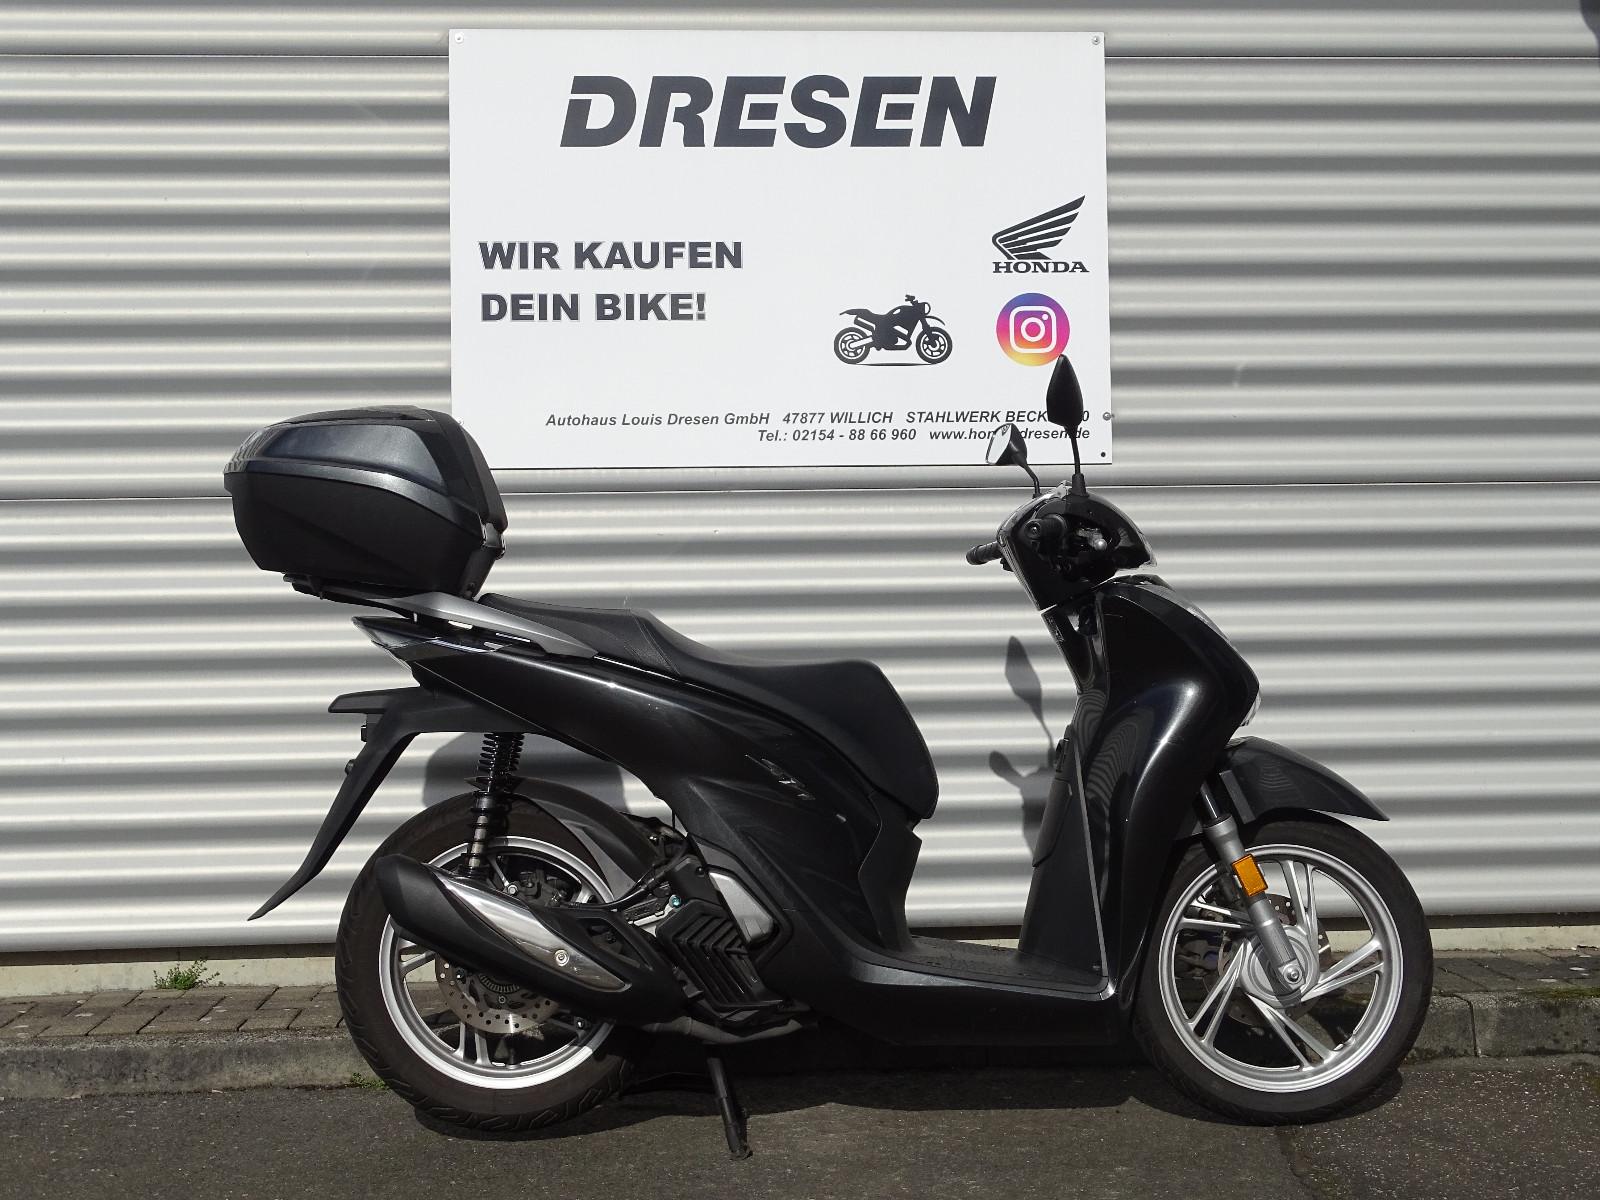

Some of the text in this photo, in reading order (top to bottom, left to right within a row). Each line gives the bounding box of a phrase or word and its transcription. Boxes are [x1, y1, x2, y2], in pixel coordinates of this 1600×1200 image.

[560, 75, 997, 148] DRESEN
[479, 241, 743, 270] WIR KAUFEN
[992, 261, 1090, 274] HONDA
[481, 293, 707, 322] DEIN BIKE!
[545, 413, 617, 427] Autohaus
[621, 413, 663, 426] Louis
[667, 413, 719, 426] Dresen
[724, 412, 770, 425] GmbH
[782, 412, 826, 425] 47877
[830, 411, 894, 424] WILLICH
[905, 410, 1001, 424] STAHLWERK
[1005, 410, 1048, 423] BECK
[758, 429, 788, 442] Tel.:
[792, 429, 835, 442] 02154
[848, 428, 866, 441] 88
[870, 428, 887, 441] 66
[891, 427, 917, 441] 960
[929, 427, 1091, 441] www.hondresende
